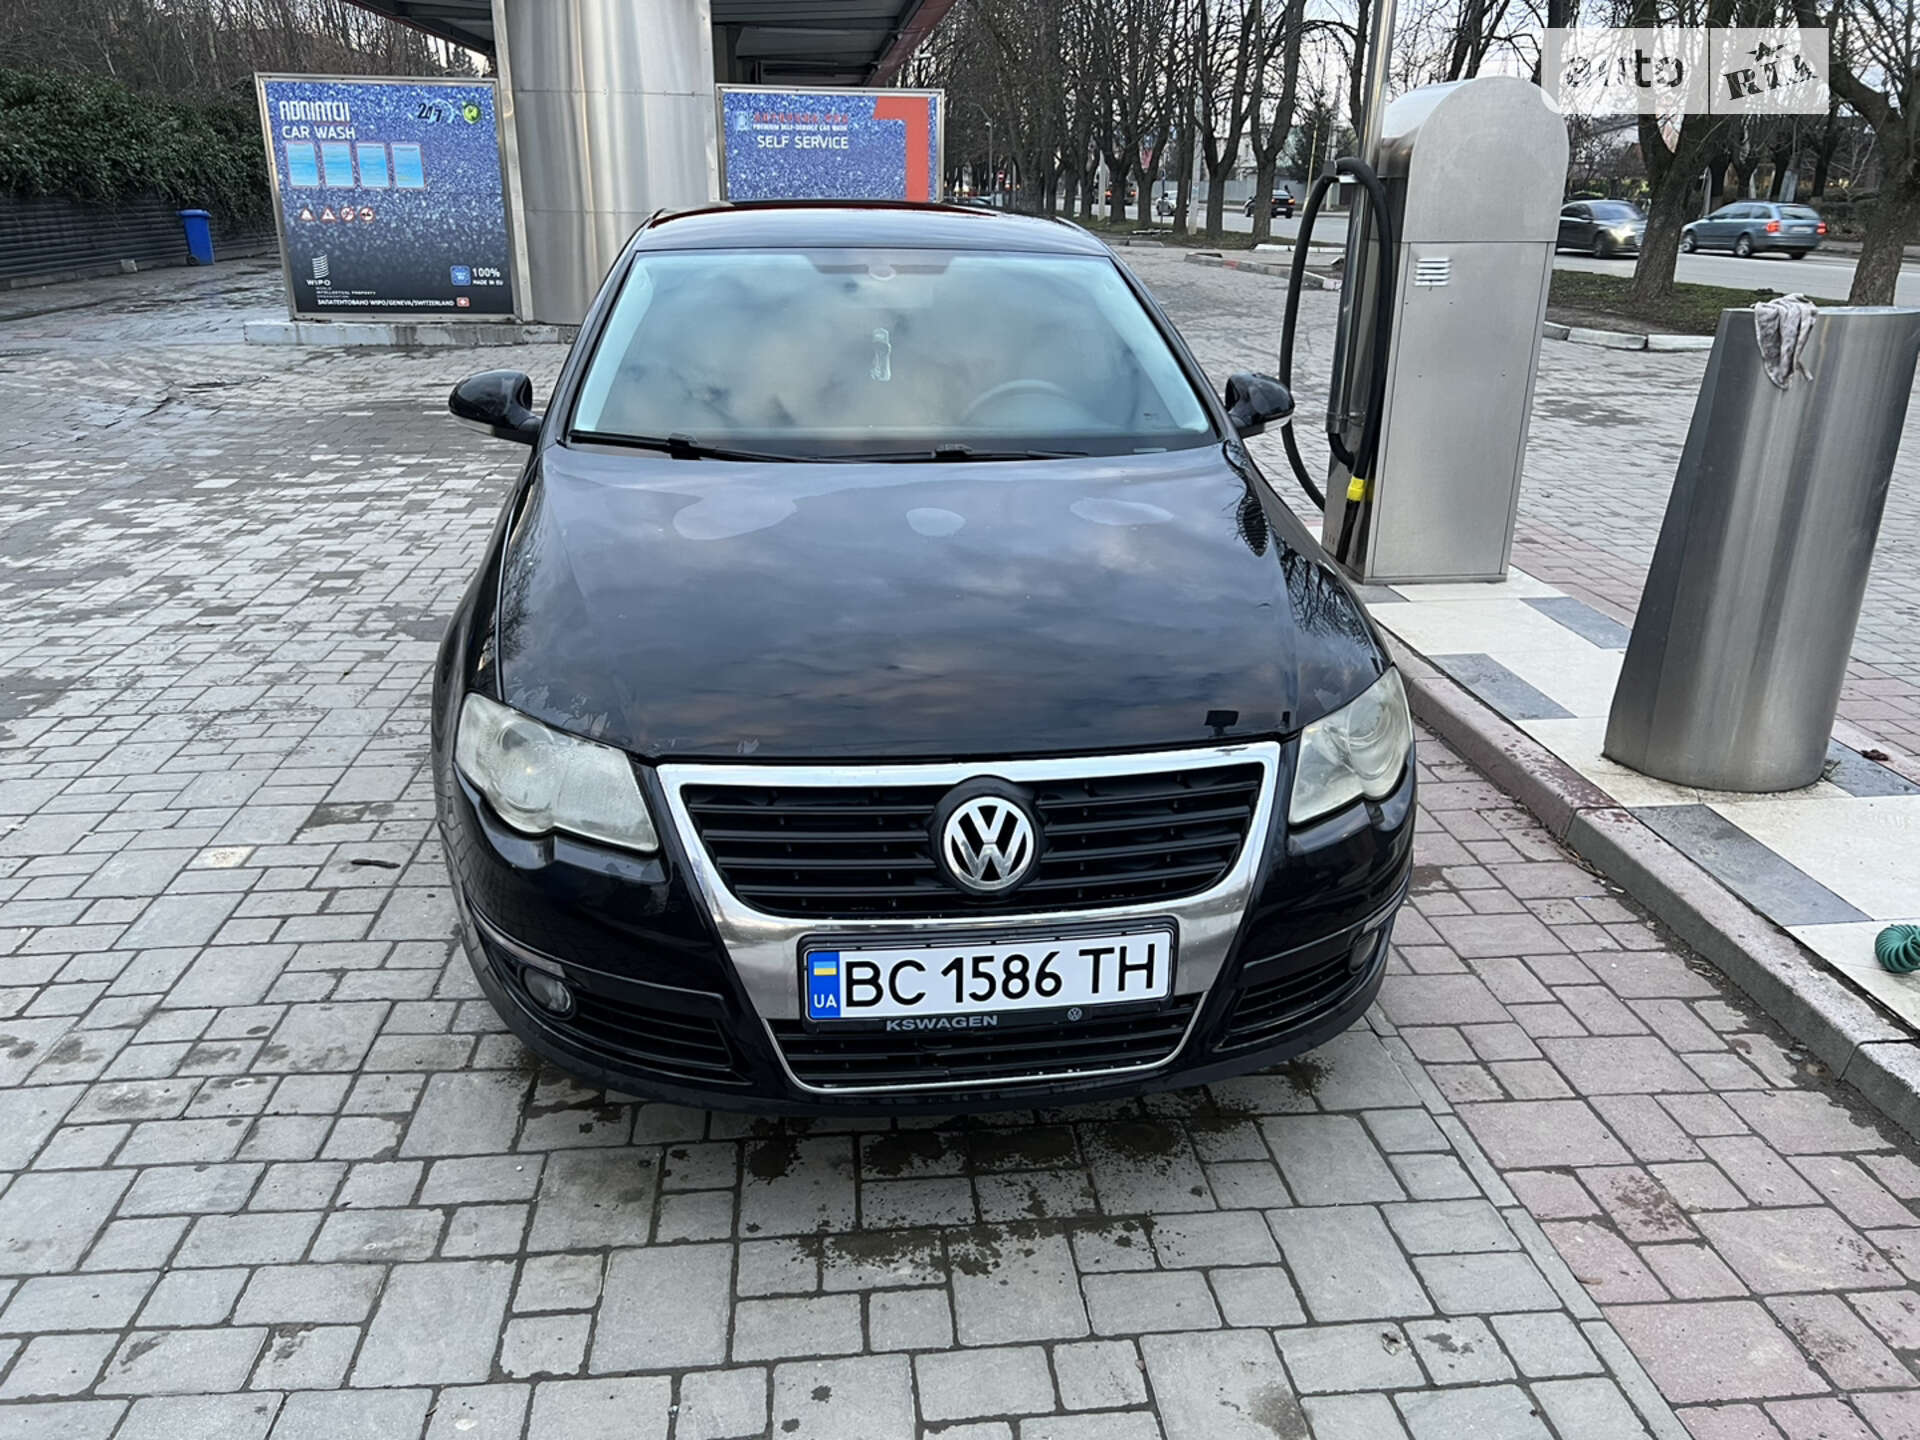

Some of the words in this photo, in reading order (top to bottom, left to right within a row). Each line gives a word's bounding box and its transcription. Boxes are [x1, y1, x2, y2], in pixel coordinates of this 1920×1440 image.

[282, 125, 311, 139] CAR
[313, 125, 356, 140] WASH
[757, 135, 790, 149] SELF
[795, 135, 849, 150] SERVICE
[472, 267, 501, 278] 100%
[305, 279, 332, 287] WIPO
[845, 959, 927, 1008] BC
[940, 951, 1063, 1004] 1586
[1078, 943, 1156, 995] TH
[814, 995, 838, 1009] UA
